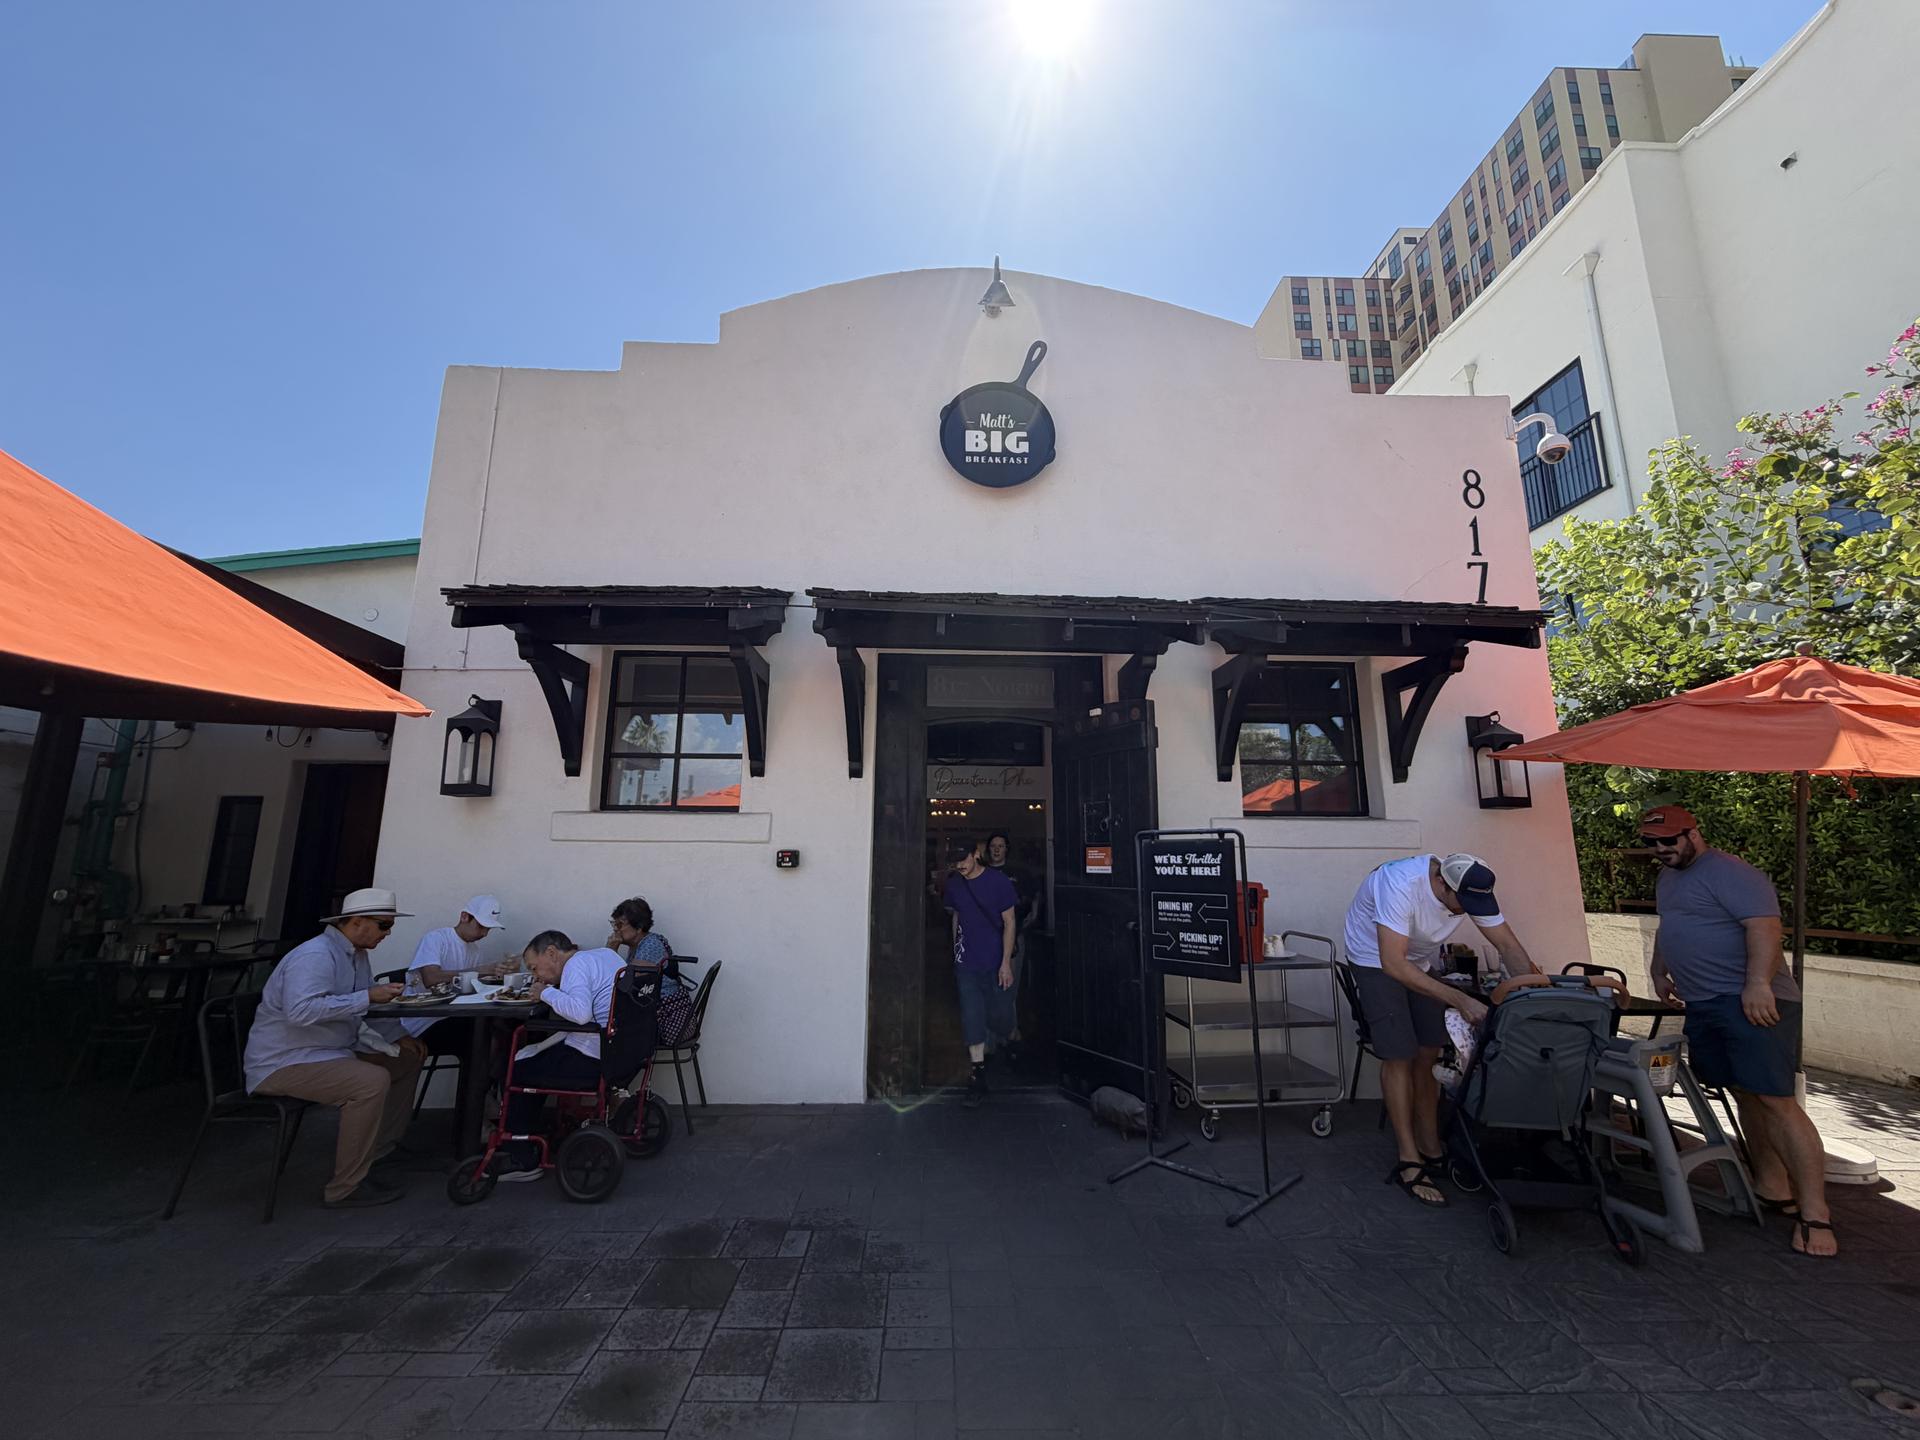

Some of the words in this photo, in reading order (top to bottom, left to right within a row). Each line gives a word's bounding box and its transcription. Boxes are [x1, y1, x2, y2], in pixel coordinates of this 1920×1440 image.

[980, 413, 1015, 428] Matt's
[965, 430, 1029, 453] BIG
[965, 456, 1028, 464] BREAKFAST
[1154, 854, 1182, 864] WE'RE
[1185, 853, 1222, 865] Thrilled
[1155, 865, 1188, 876] YOU'RE
[1191, 866, 1220, 876] HERE!
[1158, 900, 1181, 911] DINING
[1182, 902, 1193, 912] IN?
[1179, 932, 1208, 944] PICKING
[1208, 934, 1223, 945] UP?
